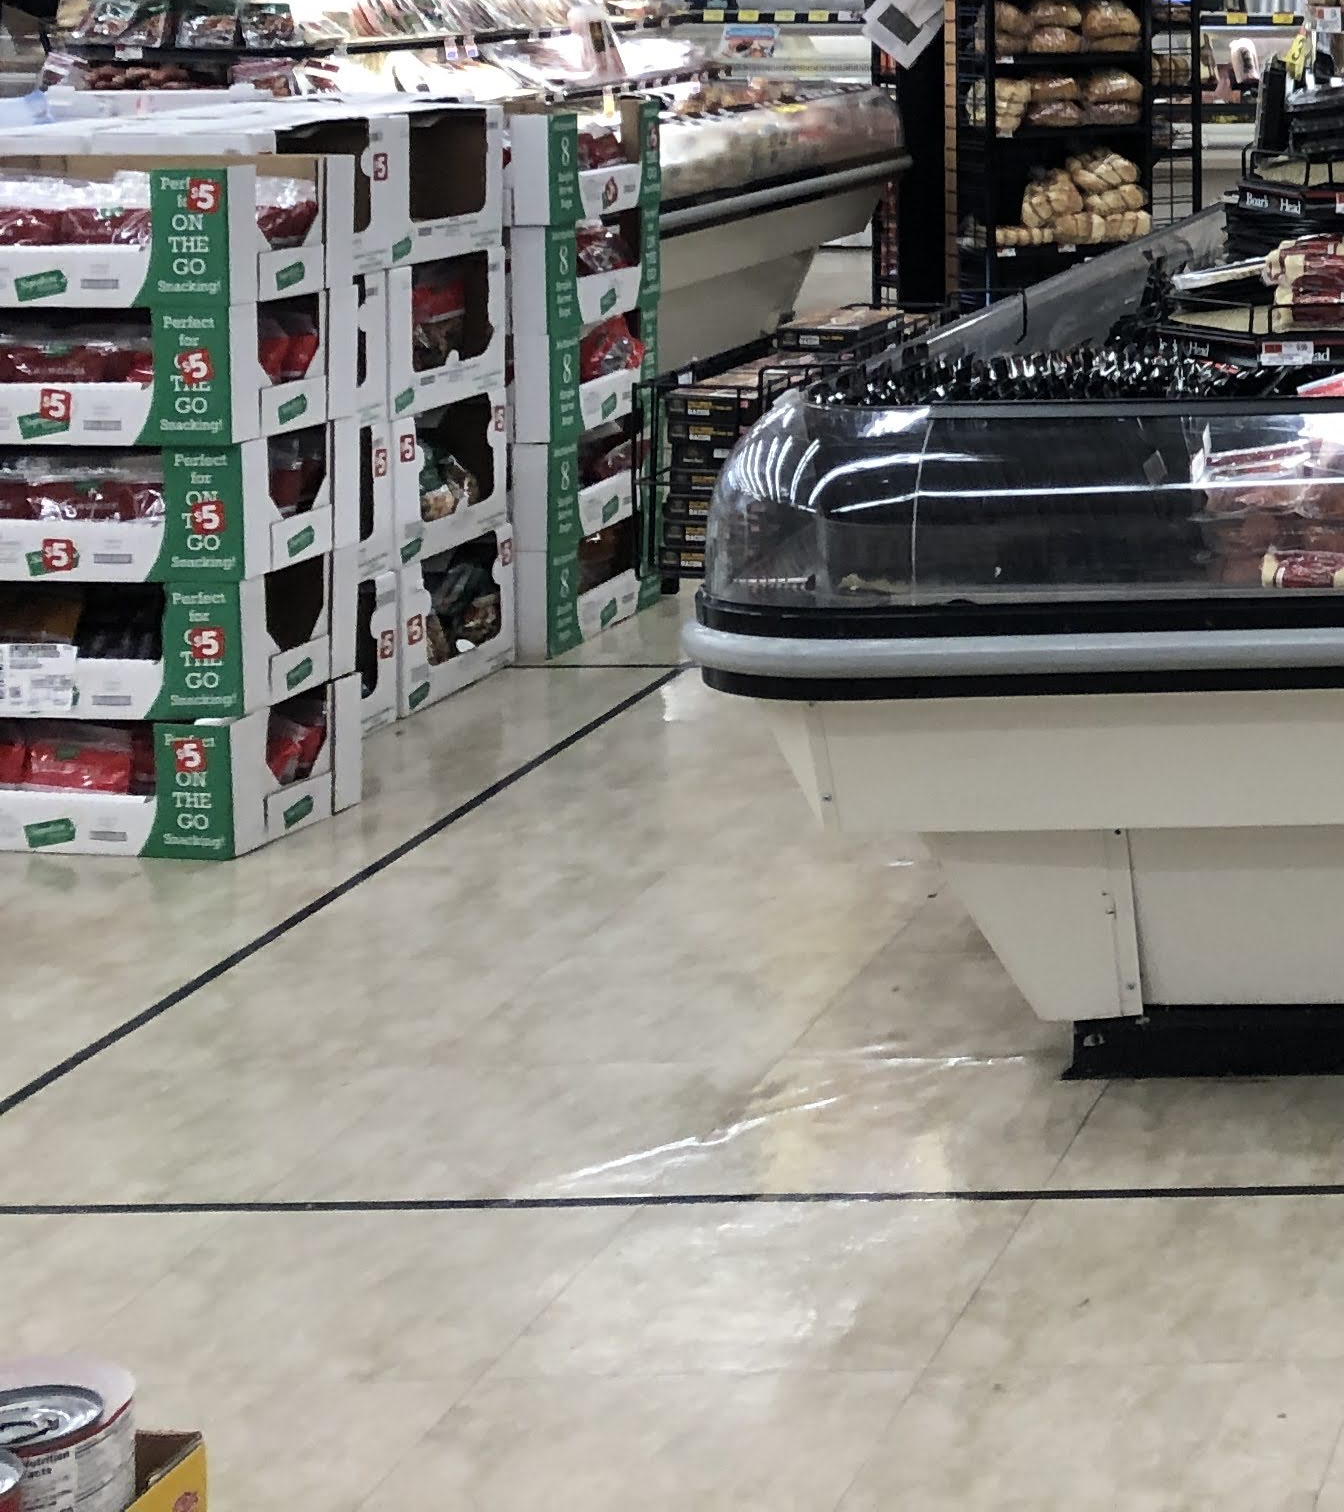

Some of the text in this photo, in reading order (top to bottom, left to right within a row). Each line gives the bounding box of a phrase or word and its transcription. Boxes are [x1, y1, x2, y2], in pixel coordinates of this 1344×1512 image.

[190, 183, 216, 211] $5
[171, 213, 204, 232] ON
[168, 236, 209, 253] THE
[172, 258, 206, 276] GO
[1312, 347, 1331, 361] ad
[182, 352, 208, 379] $5
[43, 392, 67, 418] $5
[174, 396, 208, 414] GO
[194, 504, 220, 530] $5
[186, 533, 221, 551] GO
[45, 541, 69, 568] $5
[194, 629, 219, 656] $5
[184, 672, 220, 689] GO
[177, 743, 202, 768] $5
[175, 771, 208, 787] ON
[172, 792, 213, 809] THE
[177, 813, 209, 830] GO
